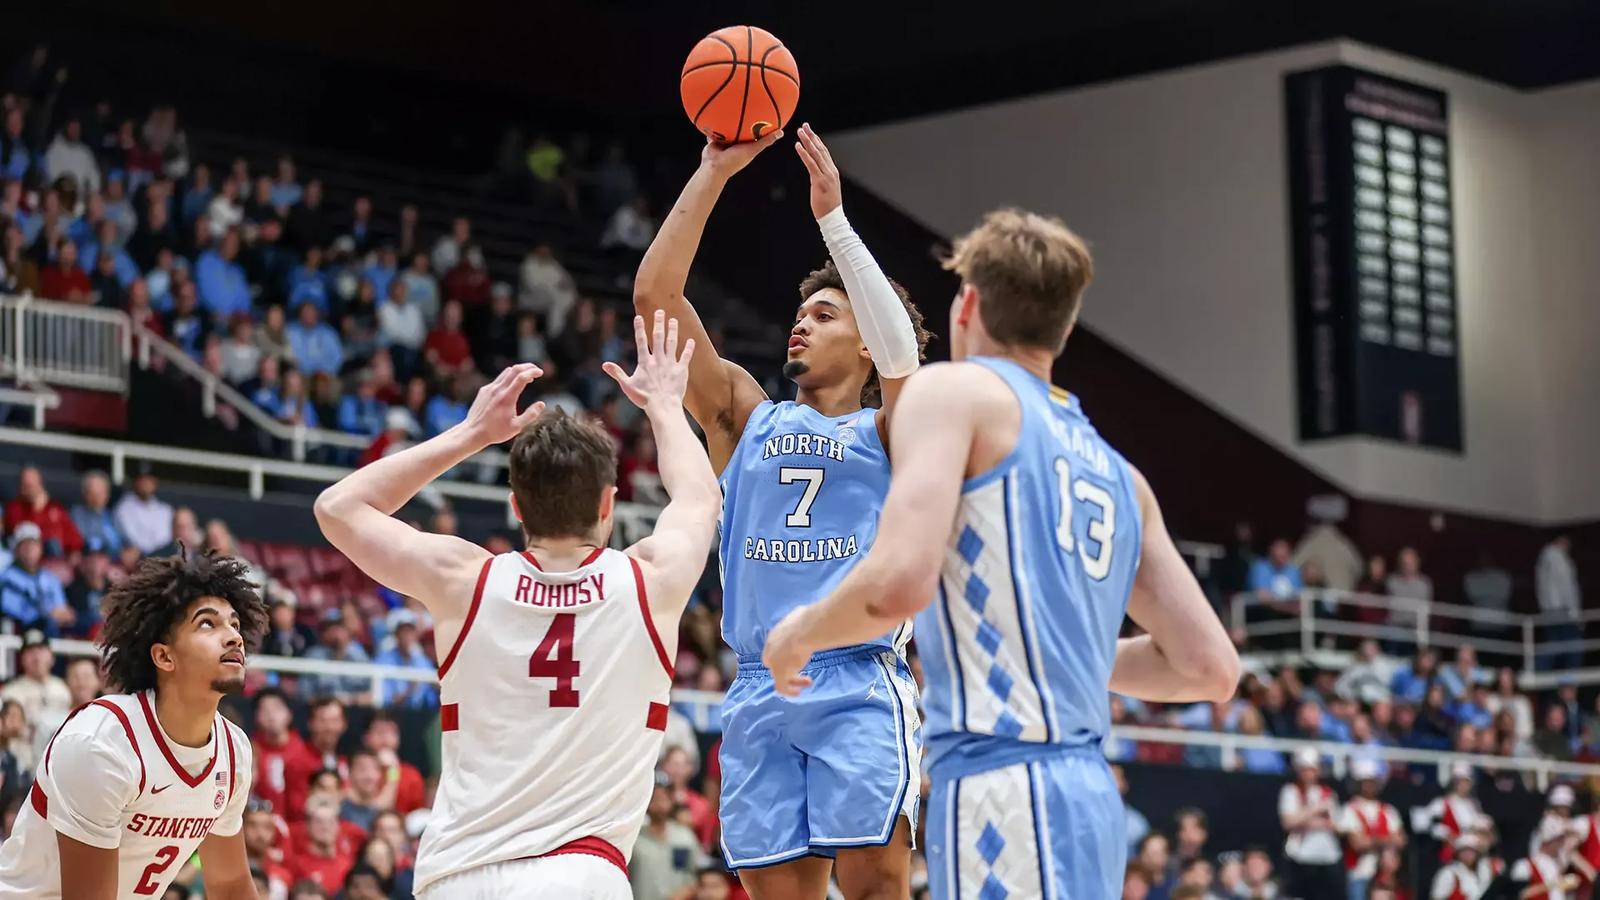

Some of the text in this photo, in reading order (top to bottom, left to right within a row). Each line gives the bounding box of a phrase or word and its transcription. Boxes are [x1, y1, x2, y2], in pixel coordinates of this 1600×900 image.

[762, 433, 845, 462] NORTH
[778, 466, 825, 528] 7
[1053, 455, 1116, 582] 13
[744, 534, 859, 563] CAROLINA
[515, 573, 605, 607] ROHOSY
[528, 613, 581, 708] 4
[126, 812, 218, 839] STANFOR
[133, 845, 180, 896] 2
